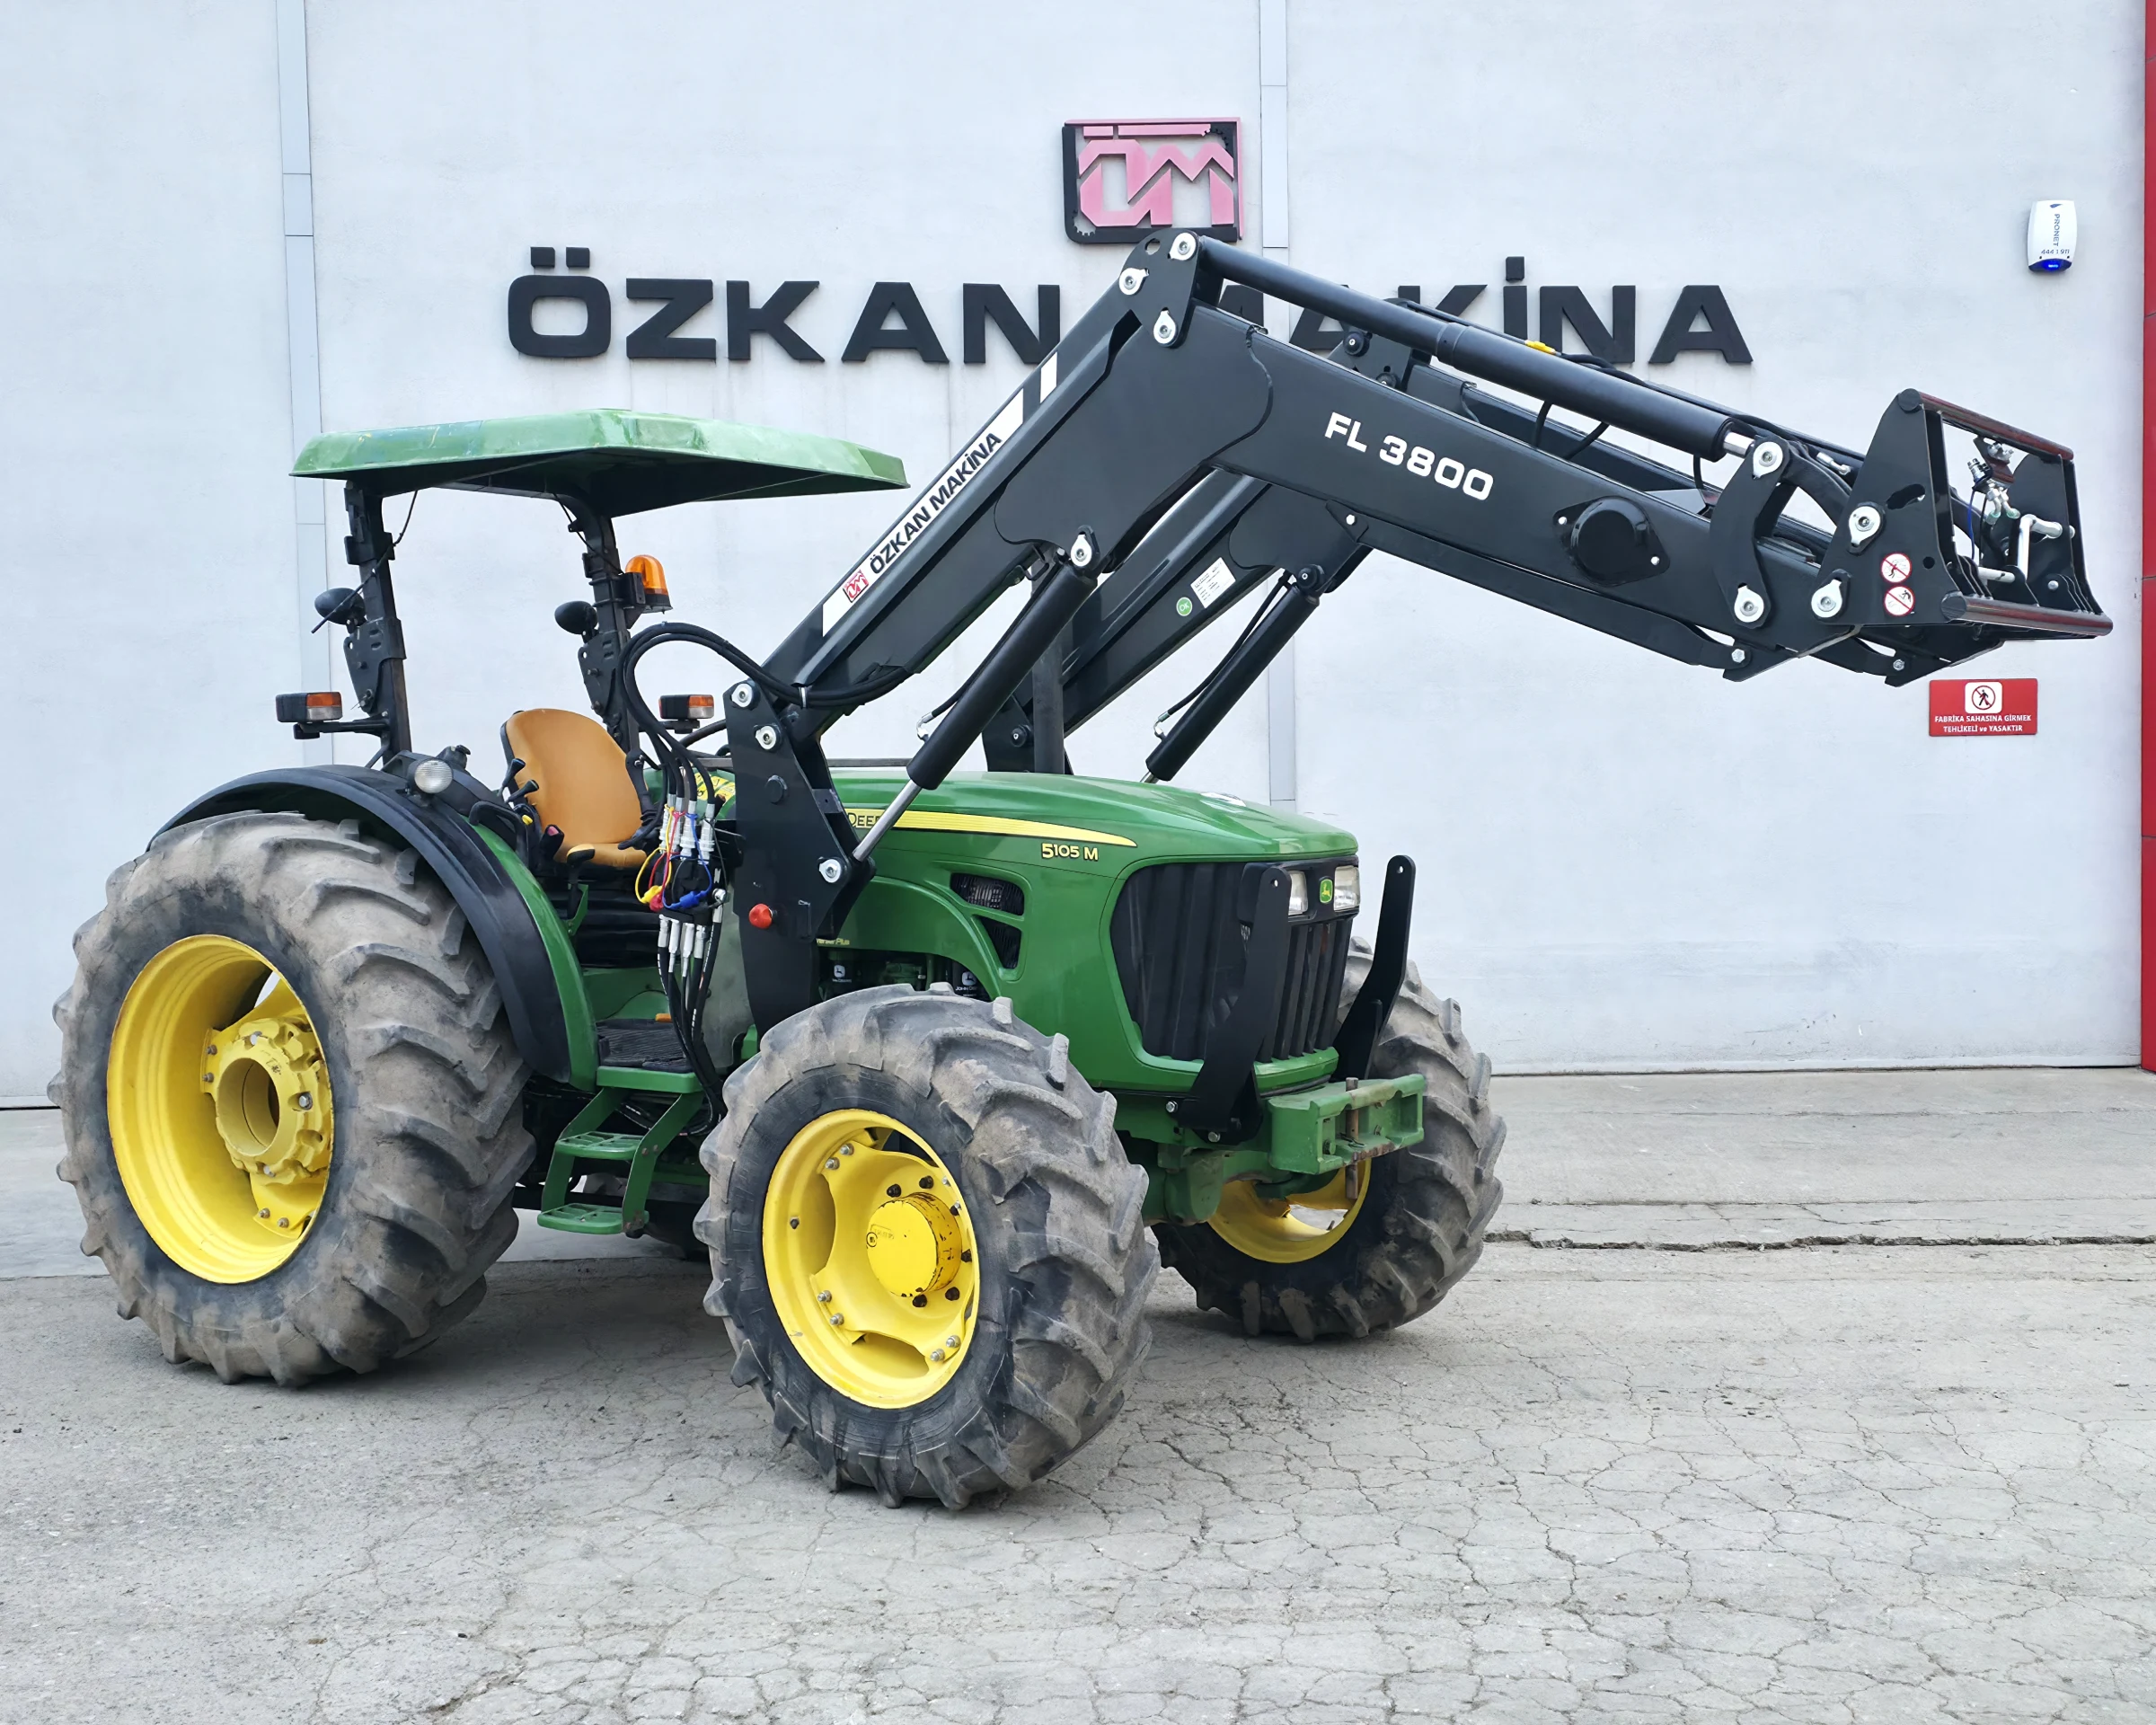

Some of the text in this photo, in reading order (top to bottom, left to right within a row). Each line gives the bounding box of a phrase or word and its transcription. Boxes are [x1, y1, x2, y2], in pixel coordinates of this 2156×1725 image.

[2053, 213, 2061, 247] PRONET
[508, 246, 1754, 365] ÖZKAN İNA
[1324, 411, 1493, 500] FL 3800
[870, 506, 932, 574] ÖZKAN
[929, 432, 1003, 511] MAKİNA
[1180, 601, 1190, 612] OK
[1934, 713, 2032, 723] FABRİKA SAHASINA GİRMEK
[1943, 724, 1978, 733] TEHLİKELİ
[1989, 724, 2023, 732] YASAKTIR
[847, 812, 881, 827] DEE
[1041, 843, 1099, 862] 5105 M
